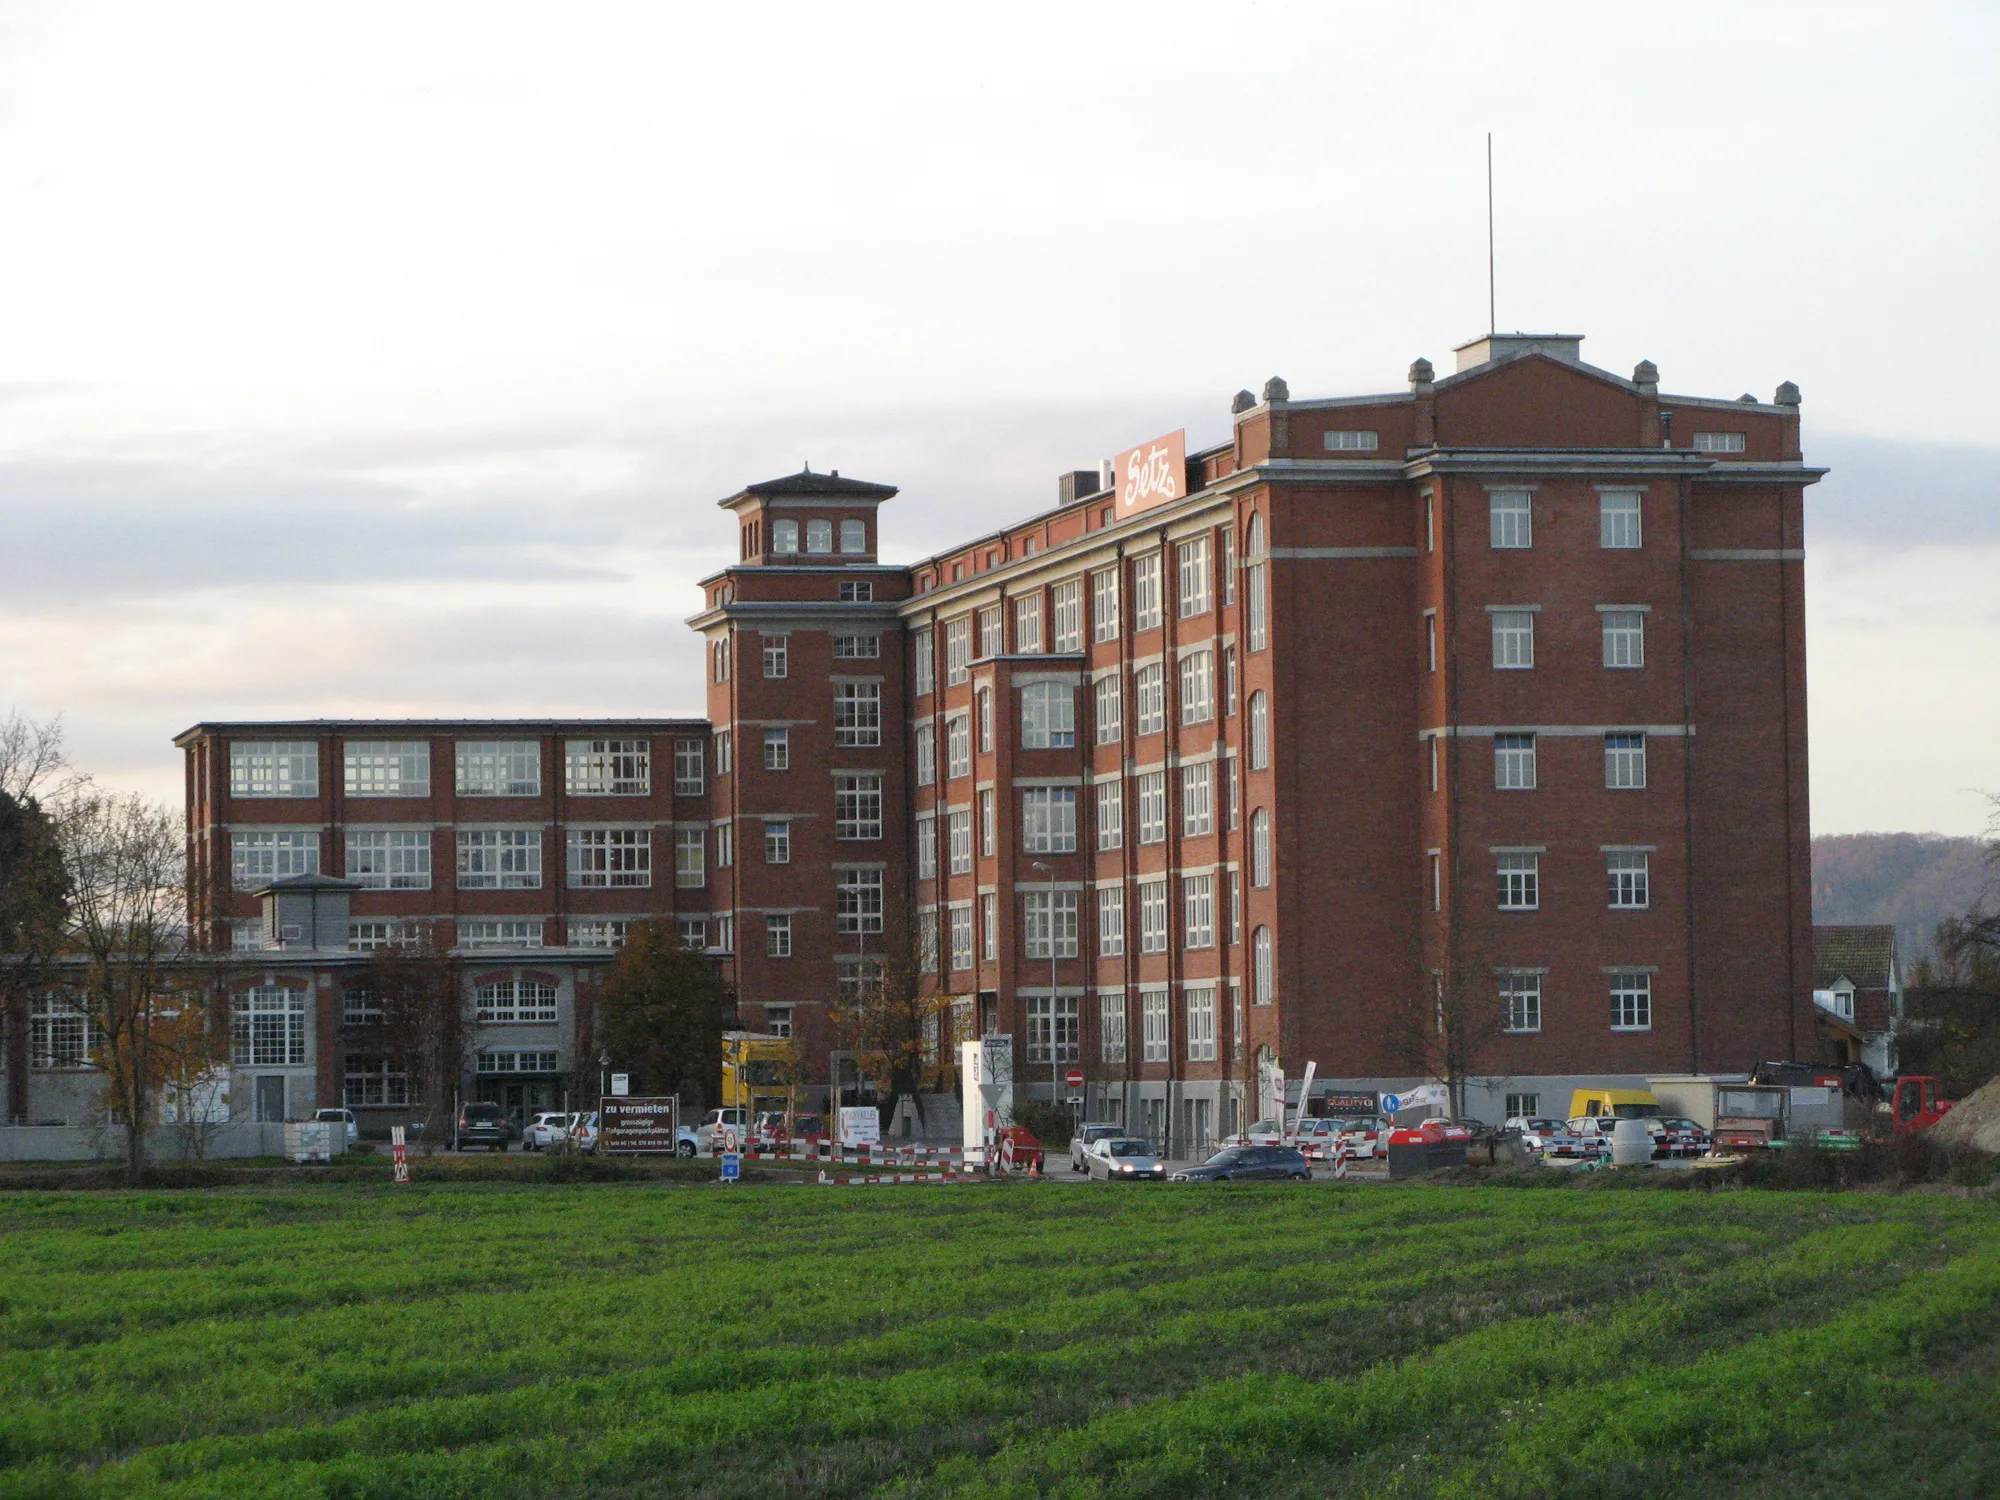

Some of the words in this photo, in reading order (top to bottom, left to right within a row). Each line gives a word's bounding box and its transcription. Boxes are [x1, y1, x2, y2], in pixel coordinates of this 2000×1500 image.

[1125, 445, 1176, 506] Setz
[605, 1106, 617, 1114] zu
[620, 1104, 669, 1114] vermieten
